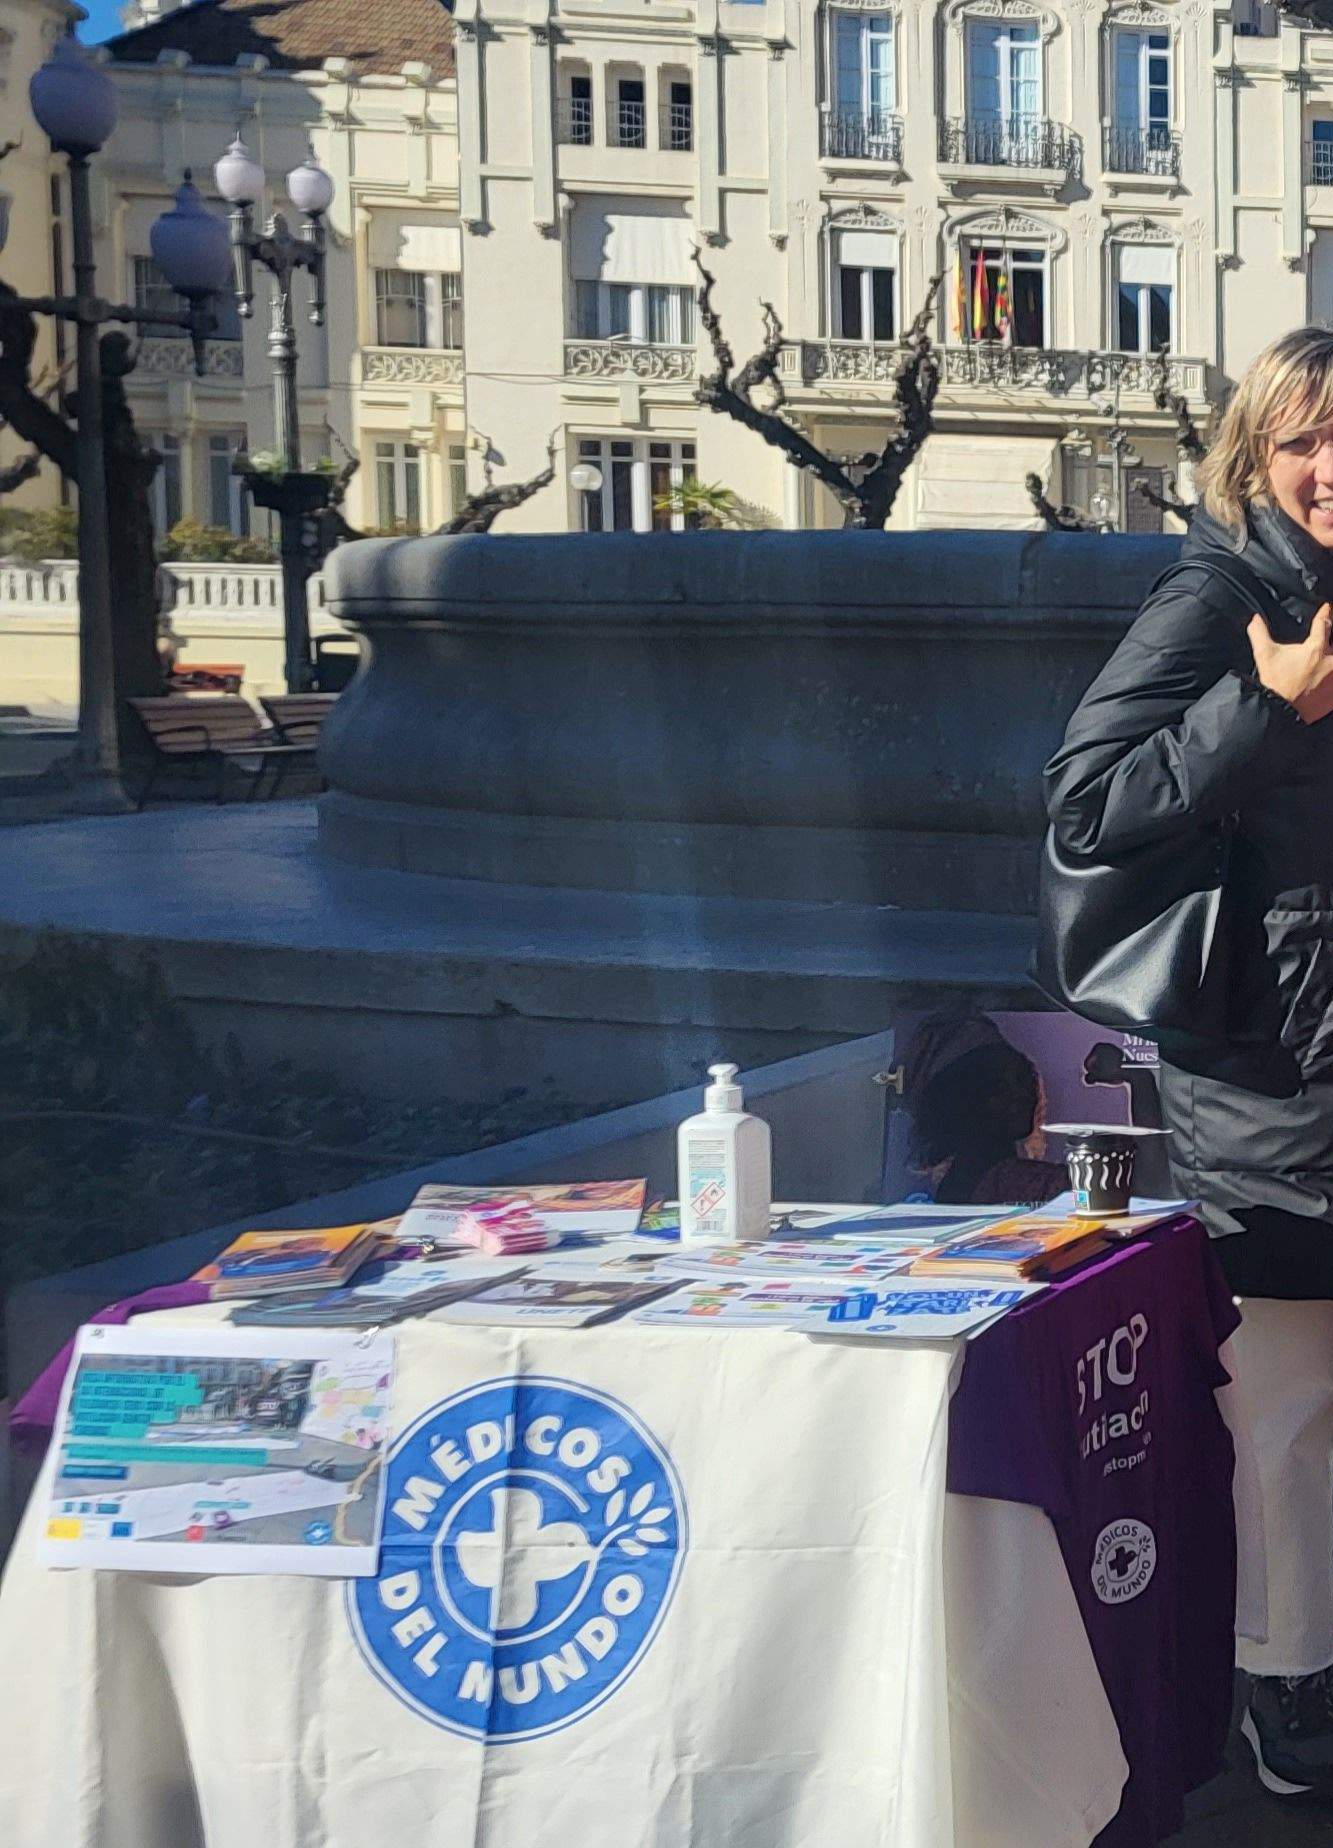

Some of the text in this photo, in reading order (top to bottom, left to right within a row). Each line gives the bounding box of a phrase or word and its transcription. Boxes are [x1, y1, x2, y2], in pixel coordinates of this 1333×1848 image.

[391, 1414, 632, 1532] MÉDICOS
[378, 1569, 645, 1706] DEL MUNDO
[1111, 1560, 1152, 1598] MUNDO
